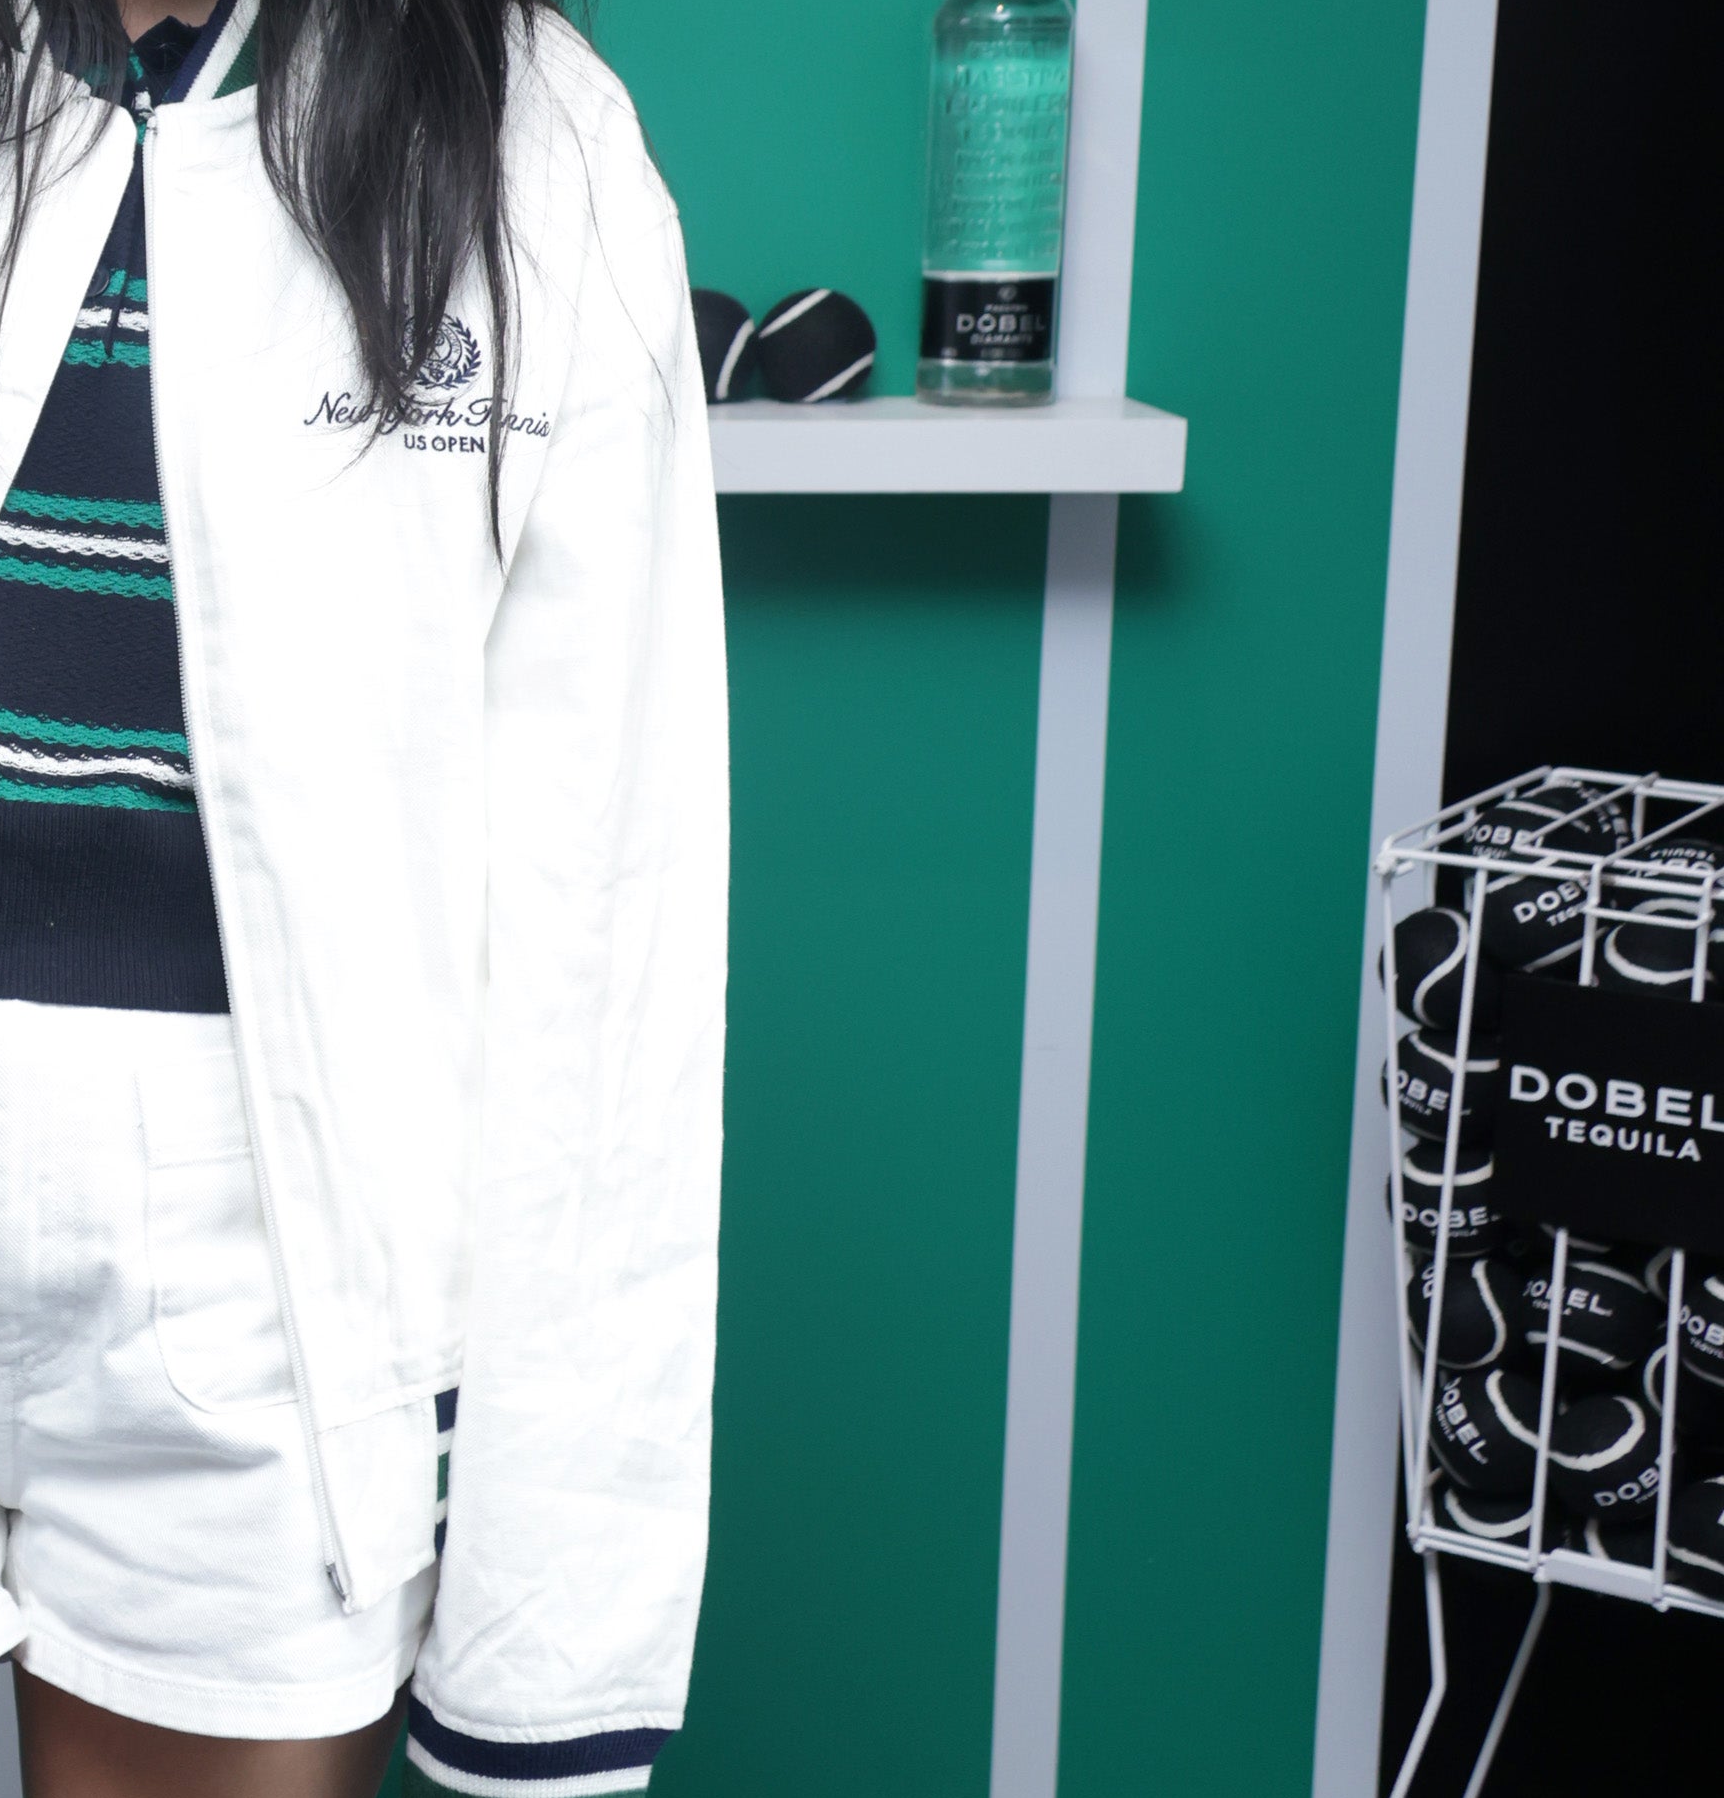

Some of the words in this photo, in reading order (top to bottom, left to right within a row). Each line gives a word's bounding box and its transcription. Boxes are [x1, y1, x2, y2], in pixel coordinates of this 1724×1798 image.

[465, 397, 550, 437] Tnnis
[404, 433, 426, 450] US
[432, 434, 485, 453] OPEN
[1510, 1064, 1724, 1133] DOBEL
[1544, 1115, 1701, 1162] TEQUILA
